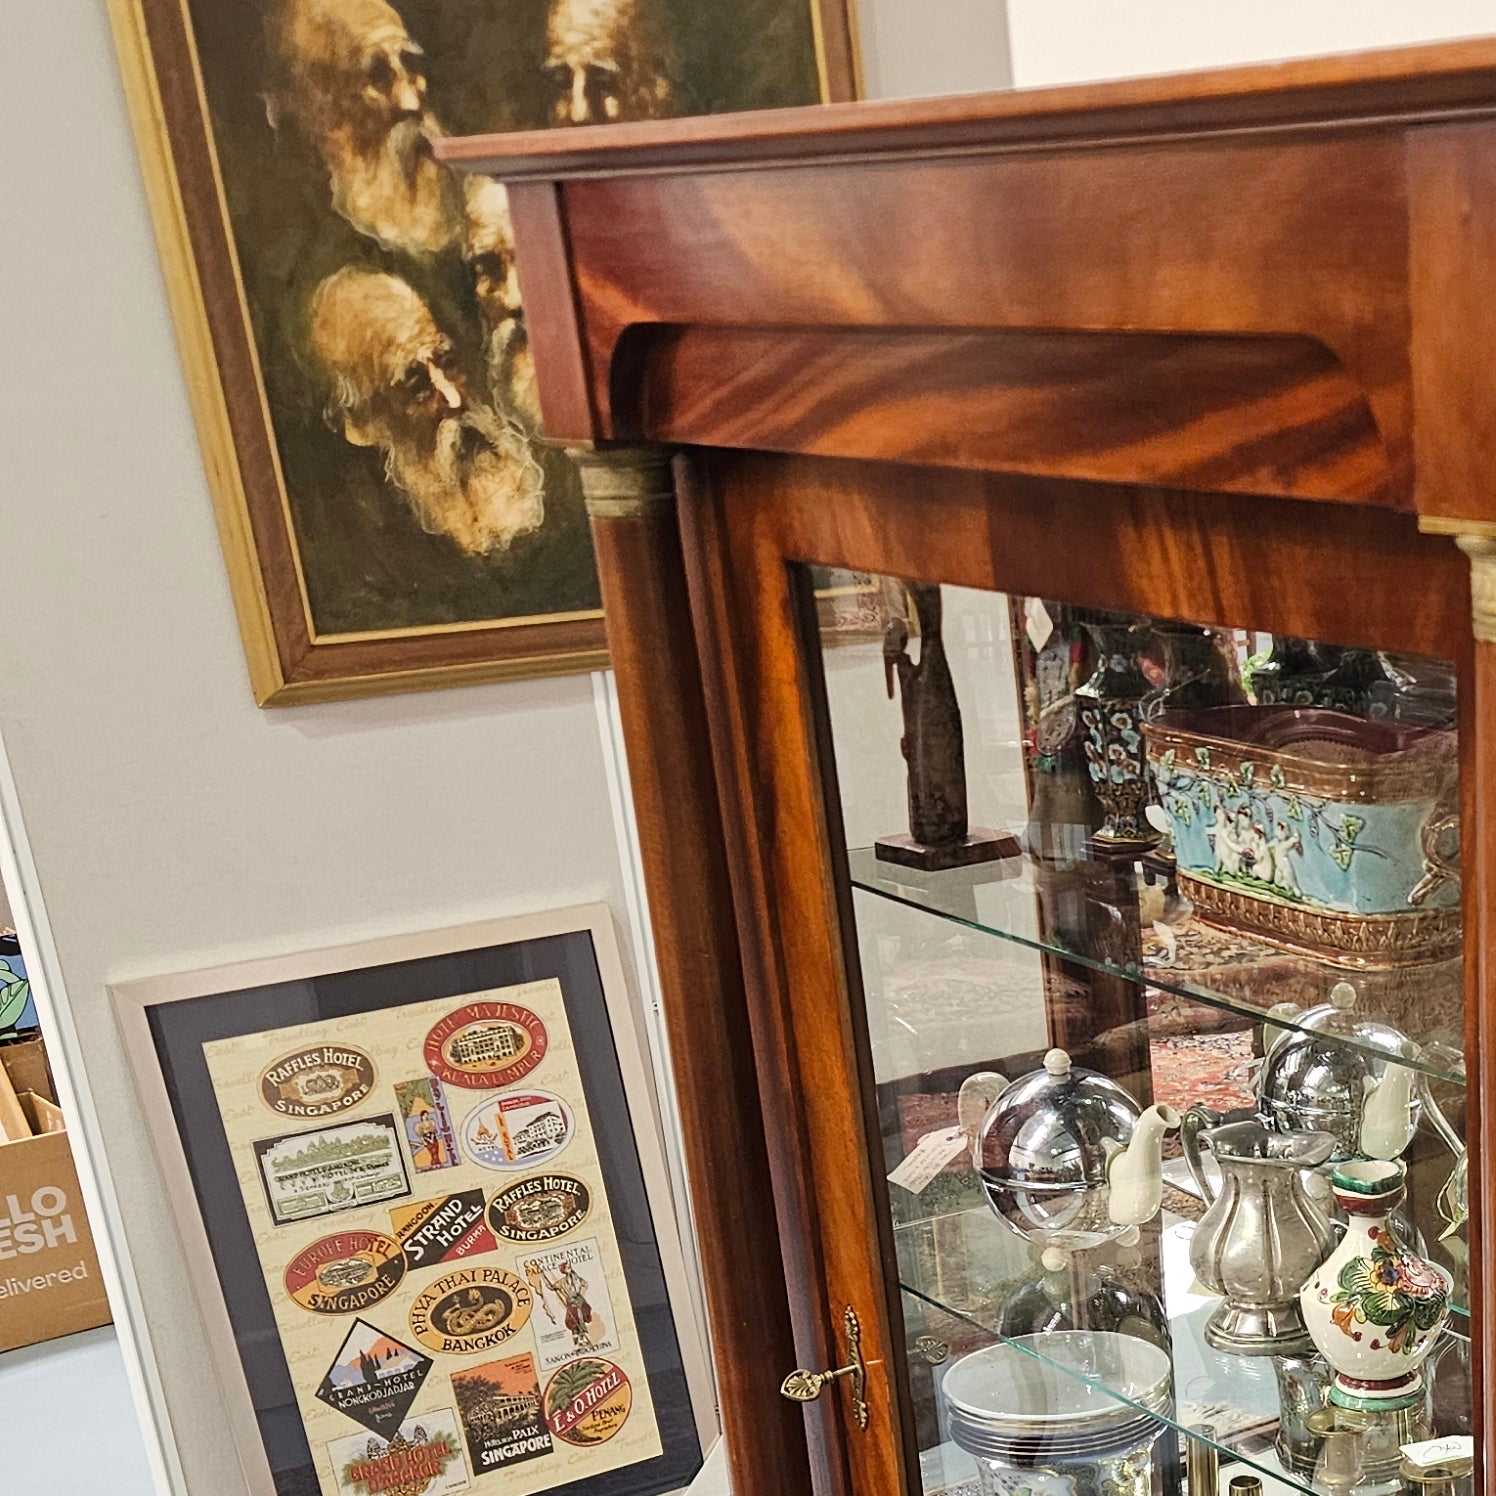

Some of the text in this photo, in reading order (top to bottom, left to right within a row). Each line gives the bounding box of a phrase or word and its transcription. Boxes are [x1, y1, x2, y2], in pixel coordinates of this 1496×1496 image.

[466, 1004, 540, 1030] MAJESTIC
[265, 1052, 321, 1087] RAFFLES
[275, 1083, 370, 1116] SINGAPORE
[493, 1179, 542, 1213] RAFFLES
[403, 1199, 463, 1261] STRAND
[436, 1204, 484, 1247] HOTEL
[455, 1224, 487, 1256] BURMA
[499, 1209, 586, 1240] SINGAPORE
[292, 1237, 391, 1277] EUROPE HOTEL
[524, 1245, 592, 1268] CONTINENTAL
[308, 1273, 396, 1311] SINGAPORE
[412, 1269, 531, 1336] PHYA THAI PALACE
[442, 1323, 516, 1352] BANGKOK
[552, 1412, 566, 1432] E
[566, 1411, 576, 1423] &
[586, 1372, 622, 1406] HOTEL
[591, 1404, 626, 1422] PENANG
[511, 1424, 540, 1440] PAIX
[480, 1434, 552, 1466] SINGAPORE
